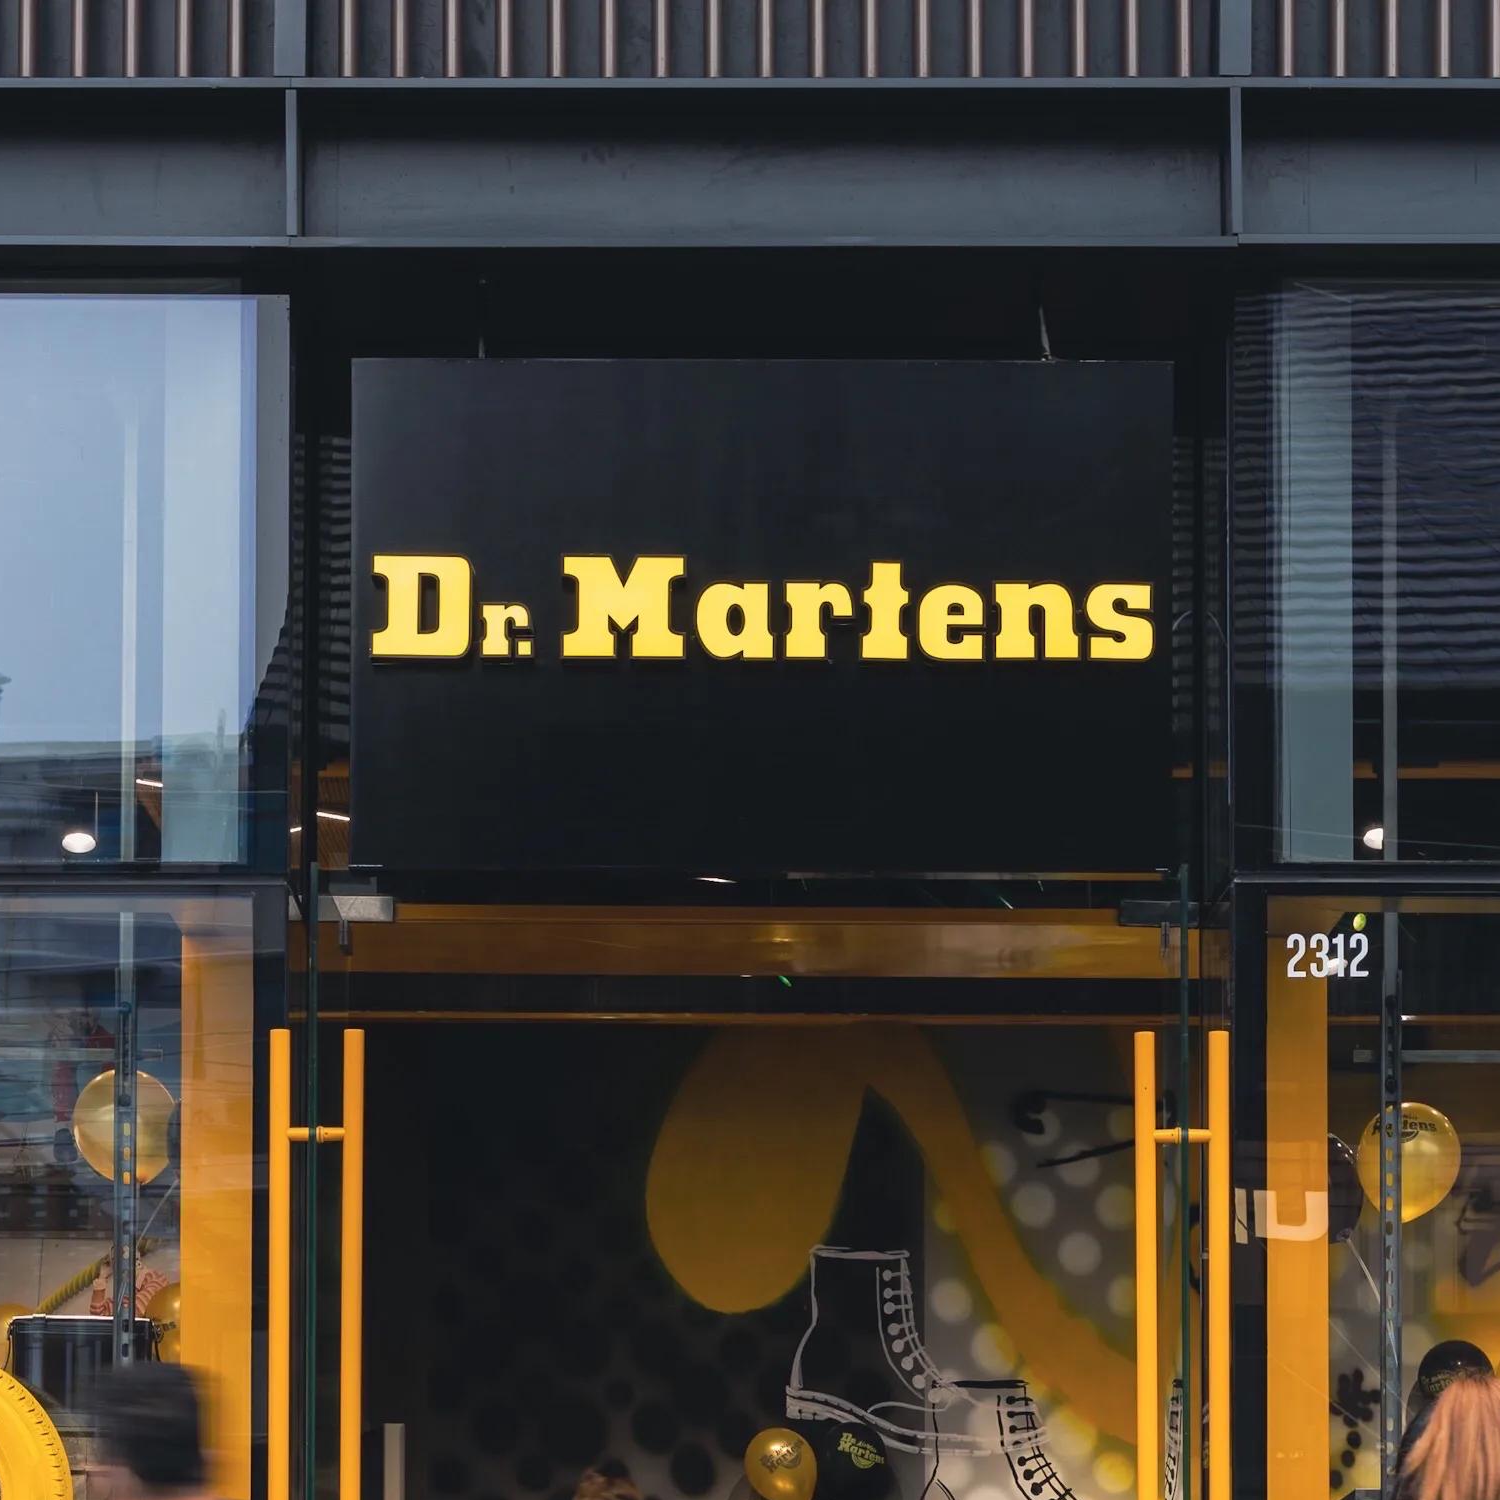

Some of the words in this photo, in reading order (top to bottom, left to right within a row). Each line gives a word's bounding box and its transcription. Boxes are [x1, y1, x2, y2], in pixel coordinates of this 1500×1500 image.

[371, 554, 533, 659] Dr.
[562, 554, 1155, 661] Martens
[1286, 932, 1369, 978] 2312
